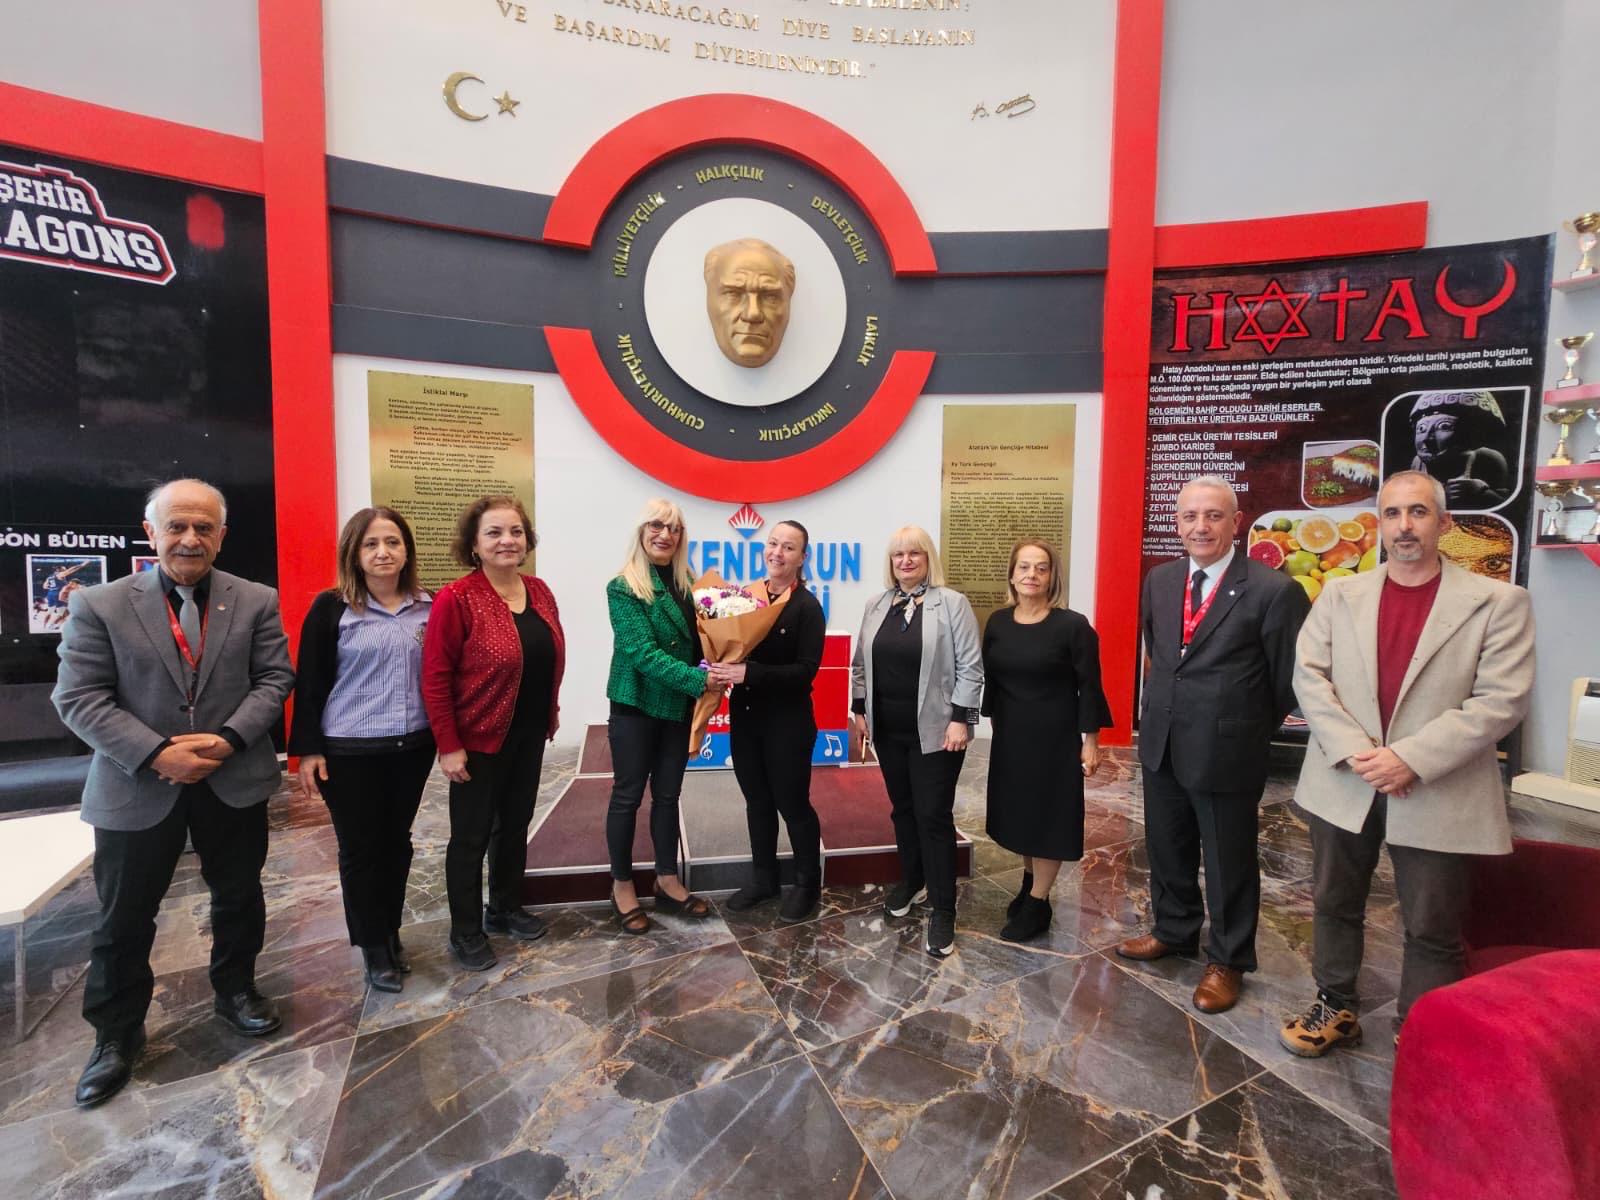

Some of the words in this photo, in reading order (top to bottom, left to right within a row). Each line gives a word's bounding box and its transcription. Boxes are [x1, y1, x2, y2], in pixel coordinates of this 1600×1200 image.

[496, 0, 528, 24] VE
[553, 13, 671, 54] BAŞARDIM
[603, 0, 760, 31] AŞARACAĞIM
[783, 17, 831, 40] DİYE
[851, 25, 976, 48] BAŞLAYANIN
[695, 164, 764, 184] HALKÇILIK
[0, 173, 93, 216] ŞEHİR
[612, 191, 667, 277] MİLLİYETÇİLİK
[810, 196, 869, 265] DEVLETÇİLİK
[0, 209, 162, 272] AGONS
[856, 315, 879, 367] LAİKLİK
[1162, 364, 1183, 374] Hatay
[1184, 364, 1231, 373] Anadolu'nun
[1231, 364, 1242, 372] en
[1242, 362, 1259, 370] eski
[1260, 360, 1294, 371] yerleşim
[1295, 358, 1358, 369] merkezlerinden
[1359, 356, 1386, 365] biridir.
[1387, 353, 1424, 363] Yöredeki
[1425, 352, 1448, 361] tarihi
[1450, 351, 1481, 361] yaşam
[1483, 347, 1529, 358] bulguları
[1211, 373, 1233, 381] kadar
[1260, 371, 1279, 380] Elde
[1279, 371, 1304, 379] edilen
[1352, 366, 1389, 376] Bölgenin
[1390, 365, 1408, 374] orta
[1495, 357, 1533, 367] kalkolit
[616, 332, 705, 431] CUMHURİYETÇİLİK
[1202, 384, 1219, 393] tunç
[1251, 382, 1278, 391] yaygın
[1279, 380, 1291, 389] bir
[1292, 379, 1327, 390] yerleşim
[1328, 378, 1345, 389] yeri
[1345, 377, 1372, 386] olarak
[1195, 404, 1218, 415] SAHİP
[1218, 403, 1252, 414] OLDUĞU
[1253, 402, 1280, 413] TARİHİ
[758, 401, 838, 441] İNKILAPÇILIK
[1148, 415, 1198, 425] YETİŞTİRİLEN
[1198, 415, 1209, 424] VE
[1209, 413, 1248, 424] ÜRETİLEN
[1248, 413, 1268, 423] BAZI
[1151, 432, 1177, 442] DEMİR
[1178, 431, 1201, 443] ÇELİK
[1202, 431, 1233, 441] ÜRETİM
[1234, 430, 1278, 440] TESİSLERİ
[1151, 443, 1180, 452] JUMBO
[1181, 442, 1215, 451] KARİDES
[1151, 452, 1202, 461] İSKENDERUN
[1202, 451, 1233, 460] DÖNERİ
[1151, 461, 1202, 471] İSKENDERUN
[1202, 461, 1245, 471] GÜVERCİNİ
[1150, 483, 1181, 491] MOZAİK
[1150, 493, 1178, 502] TURUN
[1148, 513, 1177, 522] ZAHTE
[1148, 524, 1177, 533] PAMUK
[48, 531, 126, 549] BÜLTEN
